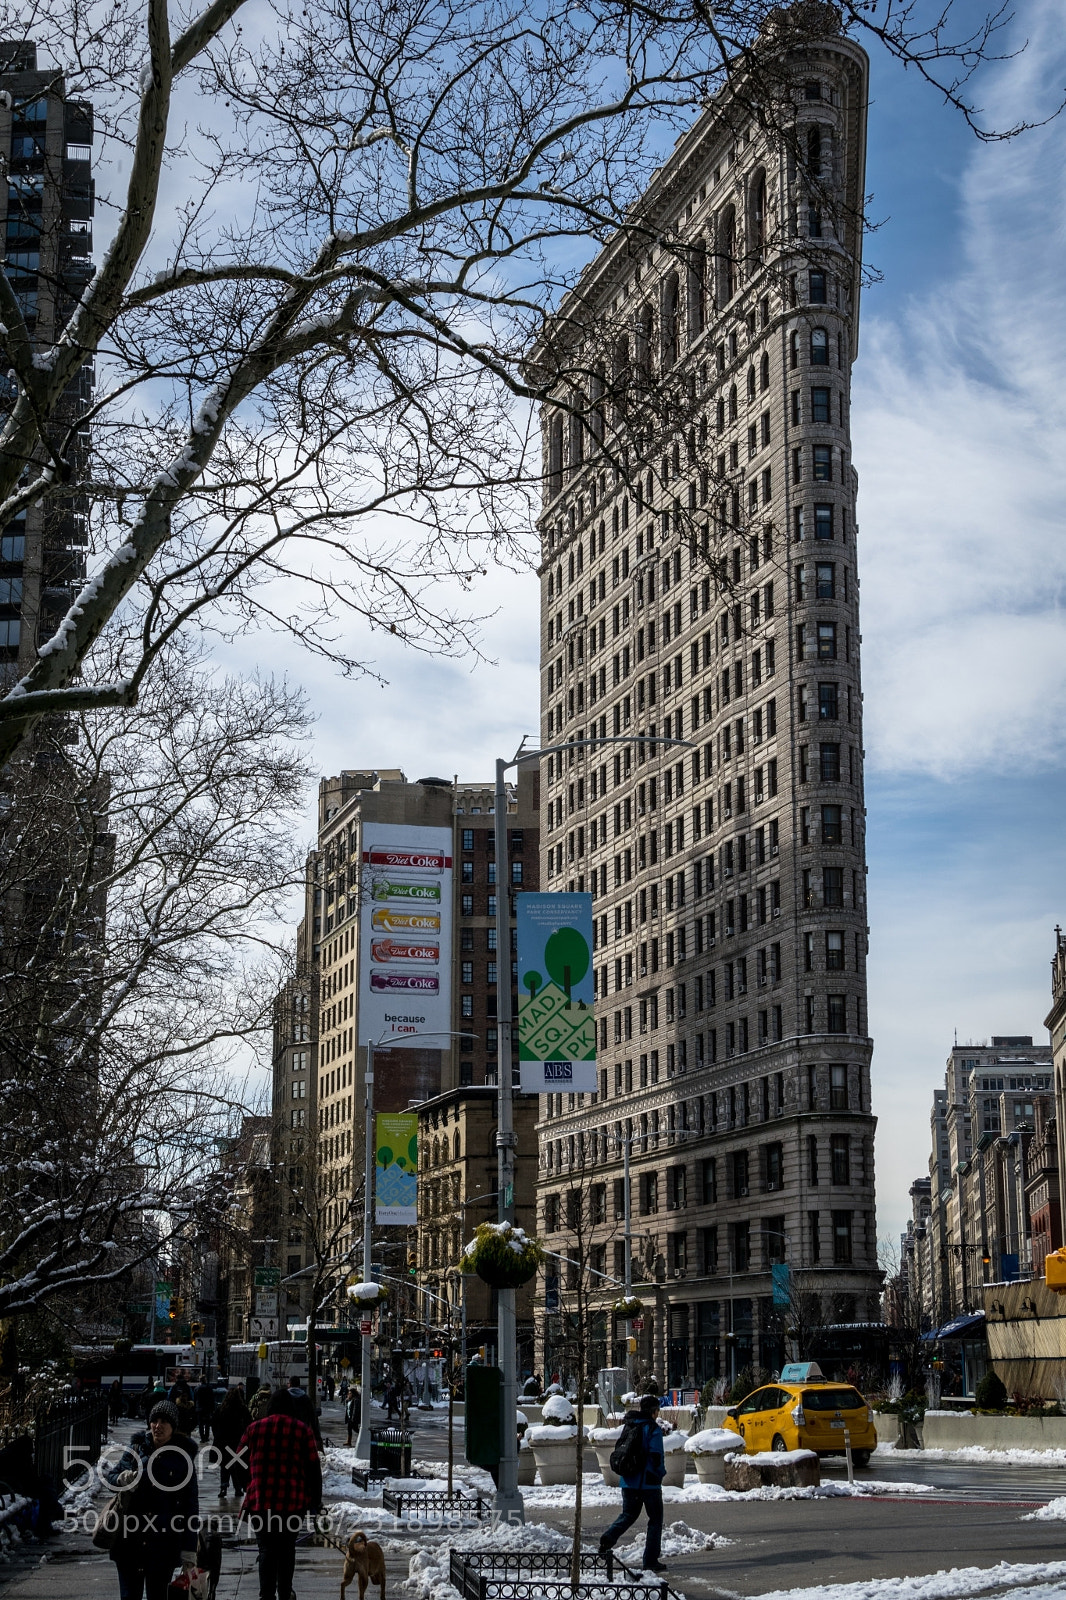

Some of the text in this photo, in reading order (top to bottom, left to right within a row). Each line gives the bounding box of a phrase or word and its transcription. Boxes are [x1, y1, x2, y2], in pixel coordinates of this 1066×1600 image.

[386, 854, 439, 867] Diet Coke
[391, 886, 436, 898] Diet Coke
[391, 916, 436, 928] Diet Coke
[391, 947, 435, 958] Diet Coke
[390, 977, 435, 989] Diet Coke
[384, 1013, 426, 1023] because
[391, 1024, 418, 1033] I can.
[534, 1027, 568, 1054] SQ.
[566, 1030, 595, 1058] PK
[544, 1063, 572, 1078] ABS
